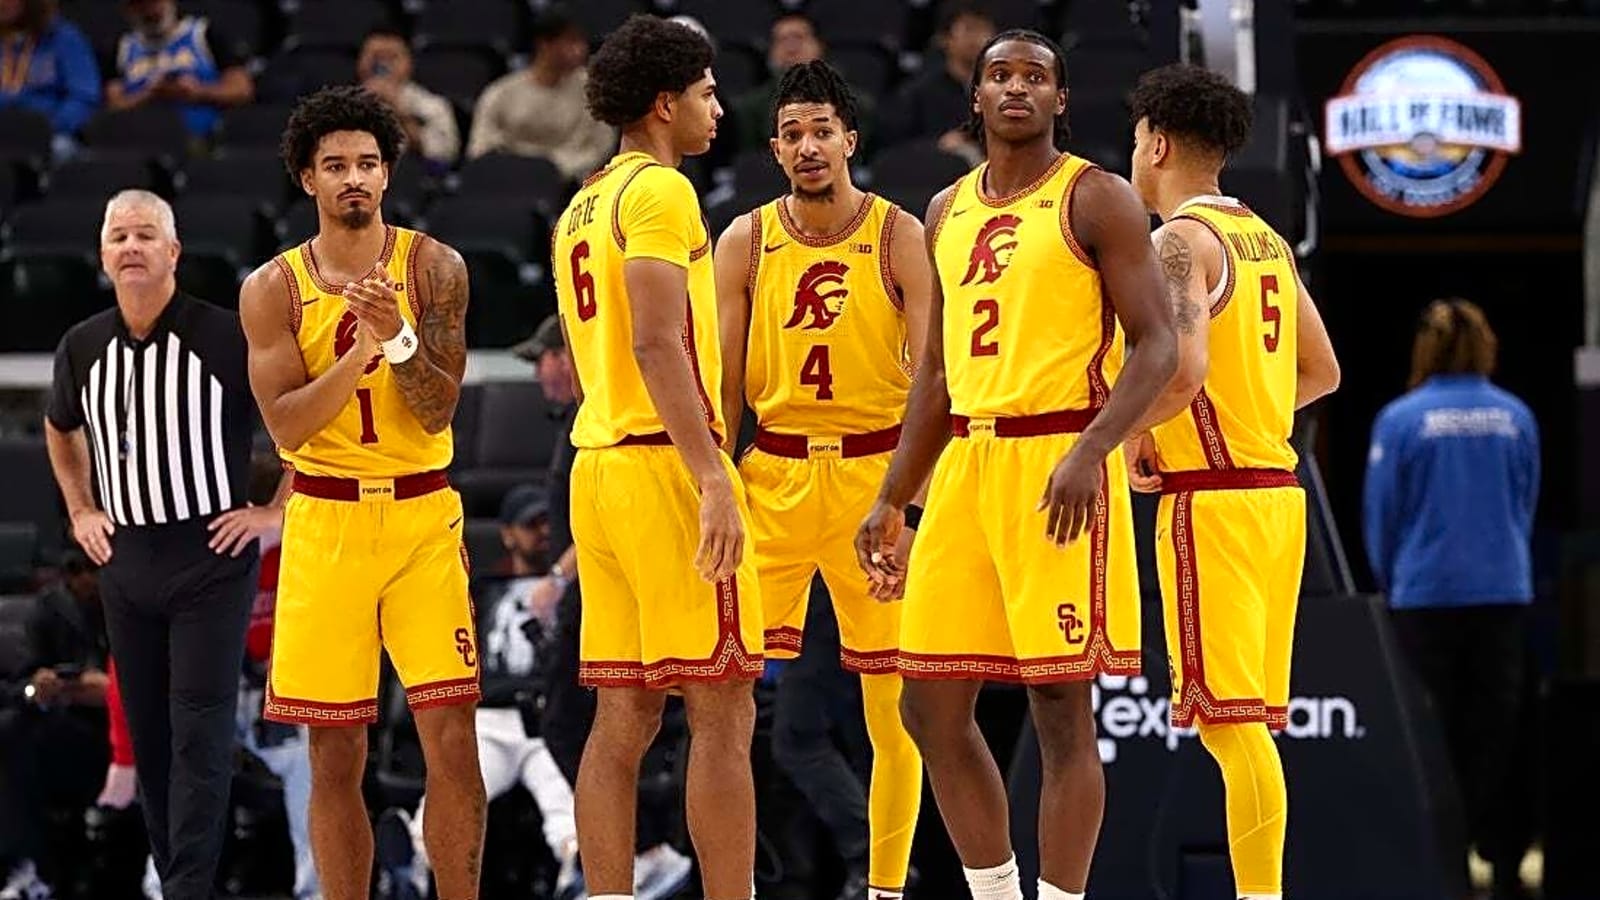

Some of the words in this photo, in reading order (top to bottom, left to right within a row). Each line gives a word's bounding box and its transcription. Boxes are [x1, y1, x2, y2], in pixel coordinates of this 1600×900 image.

[570, 240, 597, 322] 6
[971, 299, 999, 357] 2
[1260, 275, 1281, 353] 5
[800, 345, 833, 400] 4
[356, 388, 378, 444] 1
[454, 627, 476, 667] SC
[1057, 603, 1084, 644] SC
